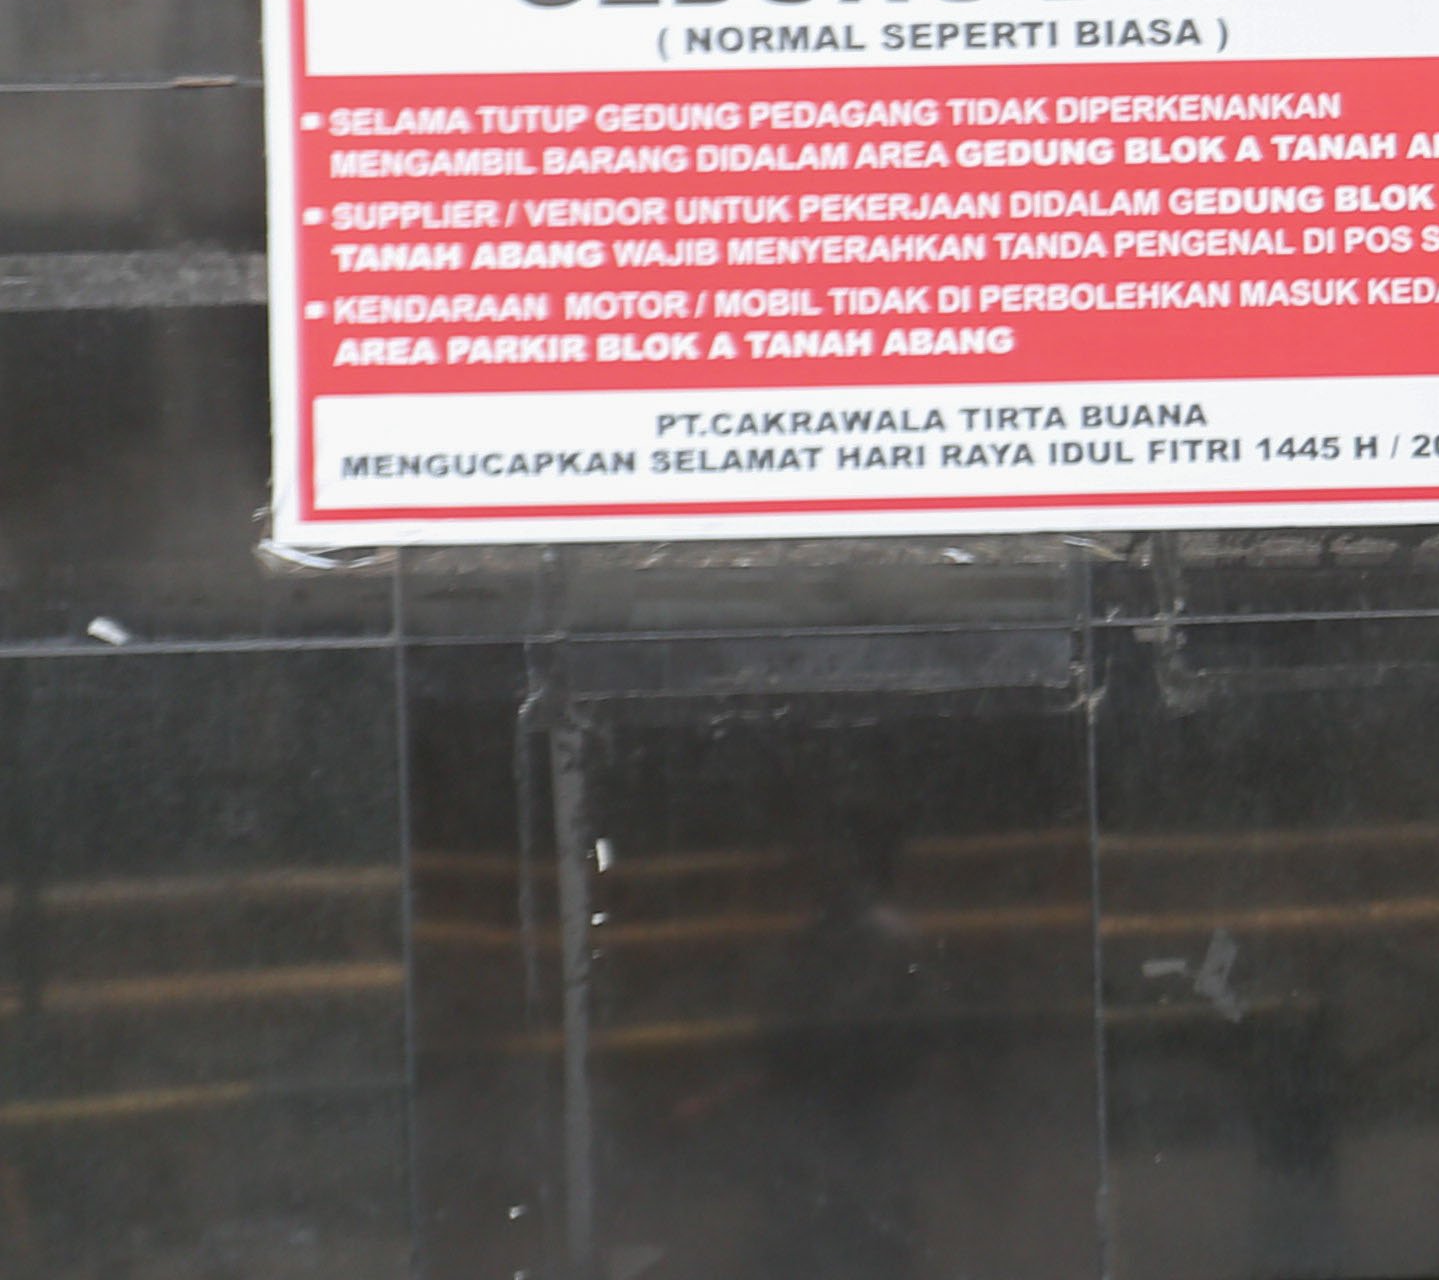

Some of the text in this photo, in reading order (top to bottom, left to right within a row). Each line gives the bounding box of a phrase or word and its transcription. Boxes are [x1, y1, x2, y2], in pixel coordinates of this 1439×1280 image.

[657, 18, 1229, 62] ( NORMAL SEPERTI BIASA )
[329, 92, 1341, 137] SELAMA TUTUP GEDUNG PEDAGANG TIDAK DIPERKENANKAN
[330, 147, 538, 178] MENGAMBIL
[542, 144, 690, 175] BARANG
[696, 142, 849, 173] DIDALAM
[854, 140, 950, 170] AREA
[955, 137, 1115, 168] GEDUNG
[1124, 135, 1227, 165] BLOK
[1234, 135, 1264, 162] A
[1270, 133, 1397, 161] TANAH
[331, 199, 500, 231] SUPPLIER
[504, 200, 519, 228] /
[523, 197, 668, 227] VENDOR
[674, 195, 793, 225] UNTUK
[798, 192, 1002, 223] PEKERJAAN
[1009, 188, 1161, 219] DIDALAM
[1168, 185, 1325, 216] GEDUNG
[1334, 183, 1435, 212] BLOK
[331, 242, 463, 272] TANAH
[471, 239, 605, 270] ABANG
[612, 237, 721, 267] WAJIB
[727, 233, 987, 265] MENYERAHKAN
[992, 231, 1109, 260] TANDA
[1114, 228, 1297, 258] PENGENAL
[1303, 227, 1336, 255] DI
[1344, 225, 1413, 254] POS
[333, 293, 549, 325] KENDARAAN
[565, 290, 690, 321] MOTOR
[694, 290, 709, 319] /
[714, 288, 823, 318] MOBIL
[827, 286, 931, 316] TIDAK
[937, 285, 972, 314] DI
[979, 281, 1232, 313] PERBOLEHKAN
[1239, 278, 1360, 307] MASUK
[333, 326, 1015, 366] AREA PARKIR BLOK A TANAH ABANG
[657, 403, 1208, 436] PT.CAKRAWALA TIRTA BUANA
[343, 451, 636, 478] MENGUCAPKAN
[652, 446, 823, 473] SELAMAT
[838, 445, 925, 468] HARI
[941, 443, 1035, 467] RAYA
[1049, 440, 1134, 465] IDUL
[1148, 438, 1241, 463] FITRI
[1257, 436, 1341, 461] 1445
[1354, 435, 1378, 459] H
[1389, 434, 1400, 460] /
